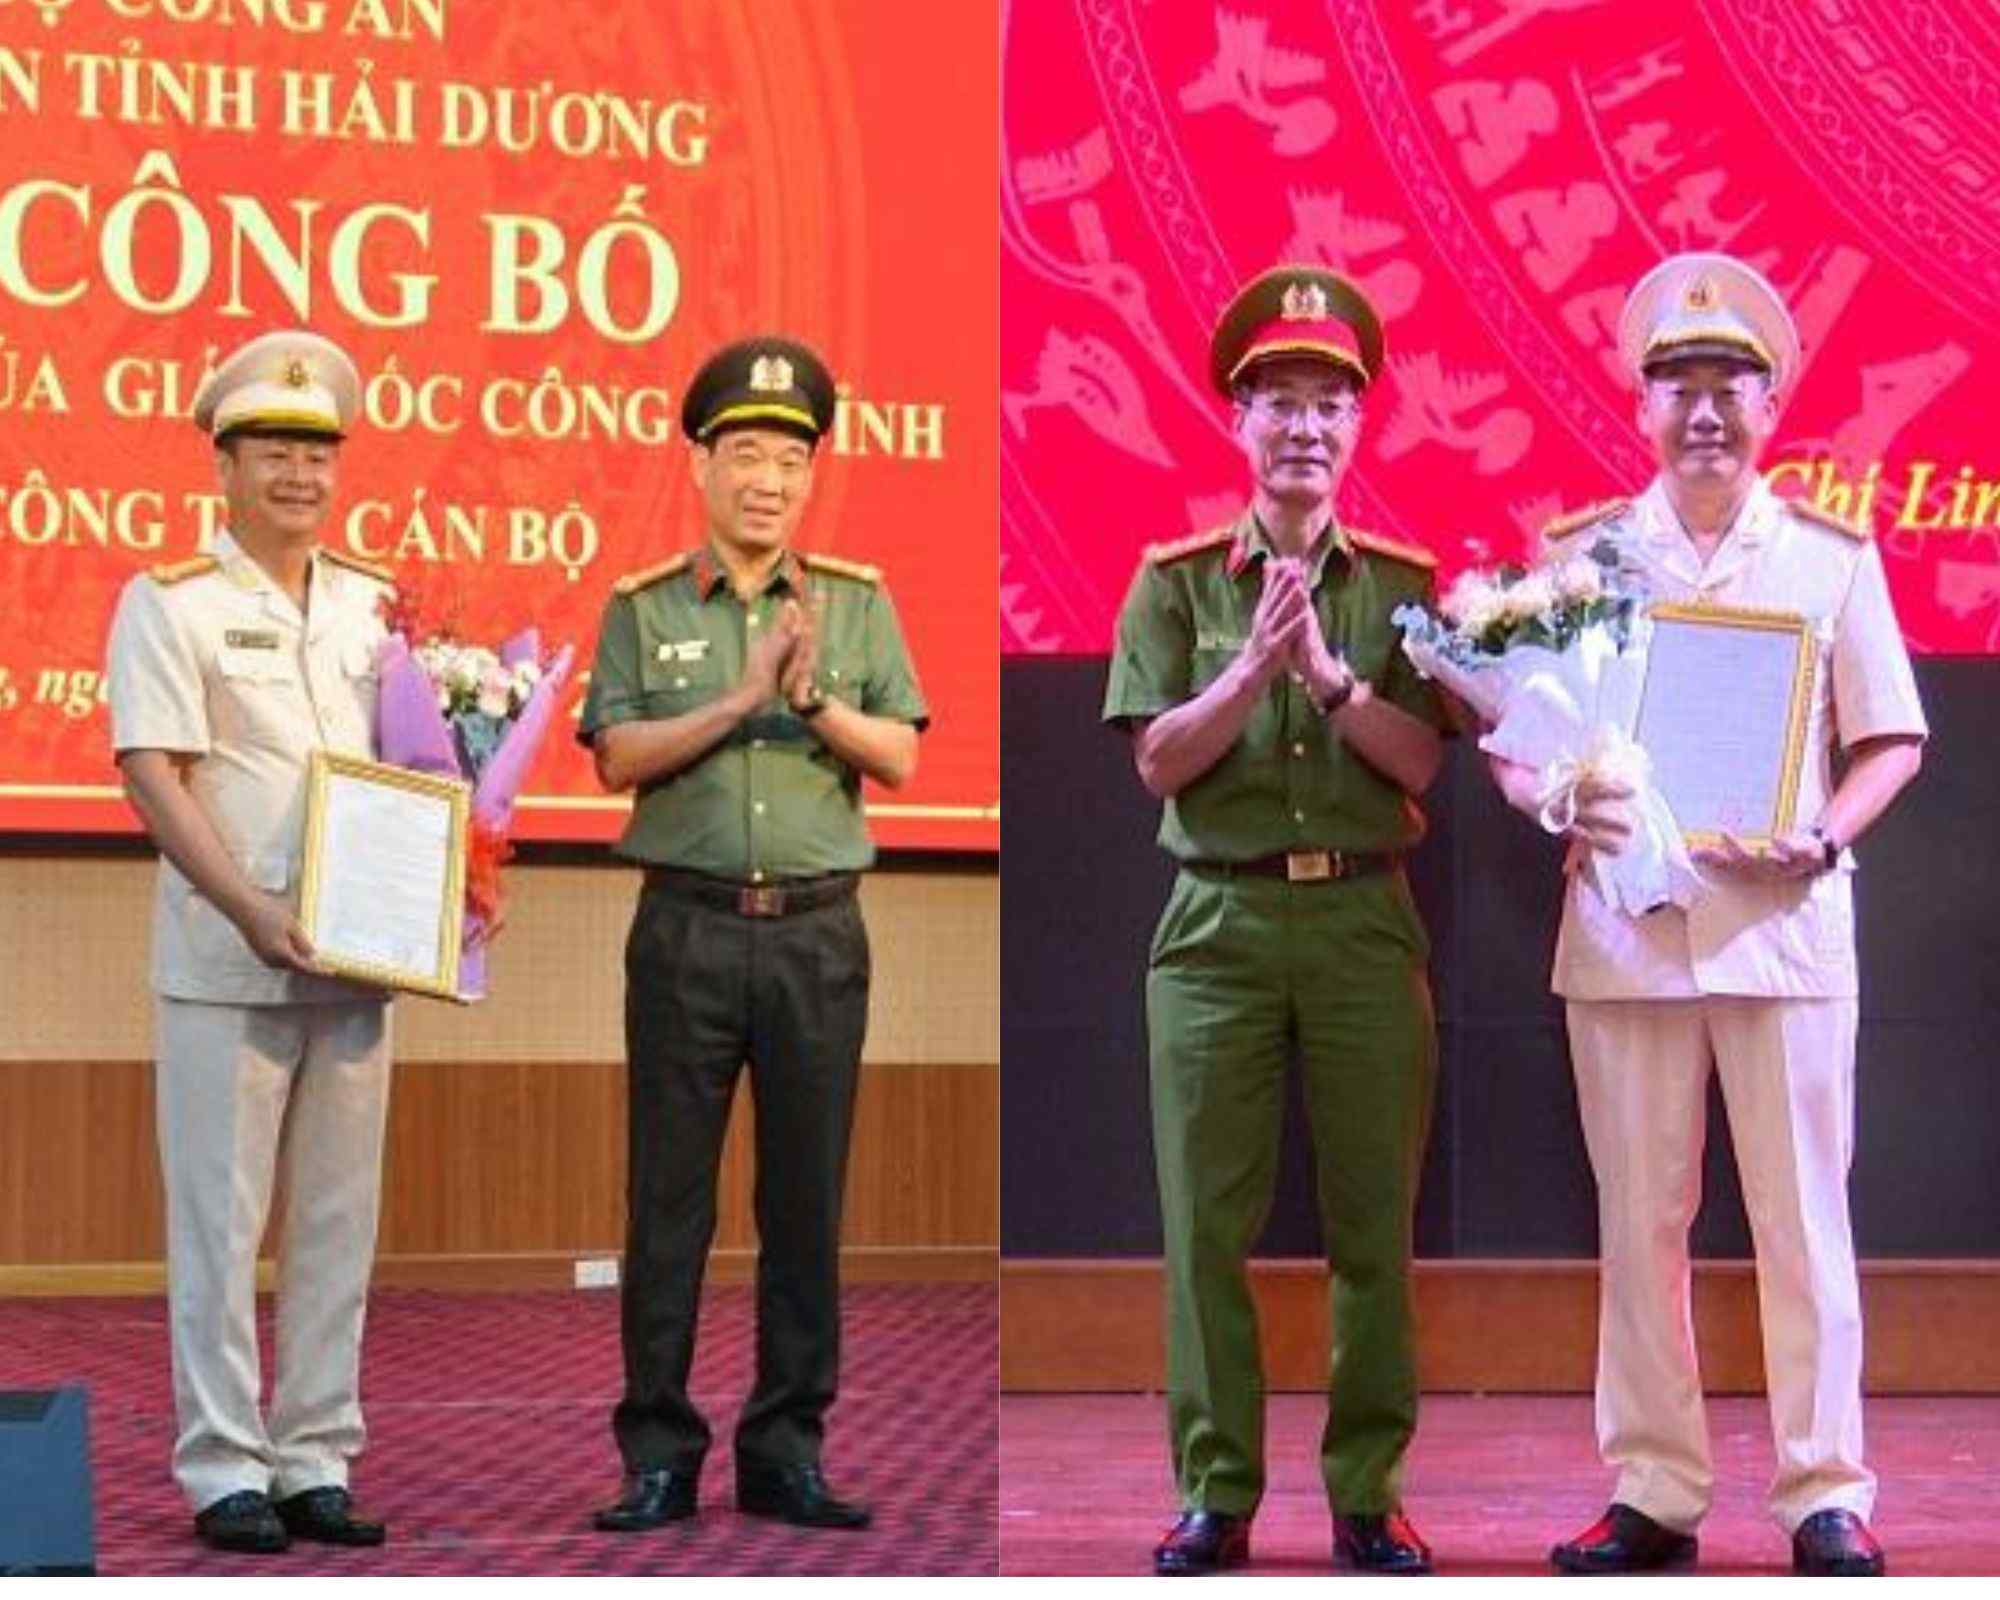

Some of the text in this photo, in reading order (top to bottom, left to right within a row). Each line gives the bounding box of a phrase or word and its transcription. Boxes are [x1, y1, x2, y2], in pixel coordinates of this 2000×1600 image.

[343, 0, 443, 41] AN
[64, 36, 256, 131] TỈNH
[281, 57, 416, 143] HẢI
[440, 80, 708, 166] DƯƠNG
[0, 149, 680, 342] CÔNG BỐ
[480, 364, 671, 444] CÔNG
[0, 468, 166, 549] ÔNG
[345, 486, 489, 562] CÁN
[507, 500, 600, 582] BỘ
